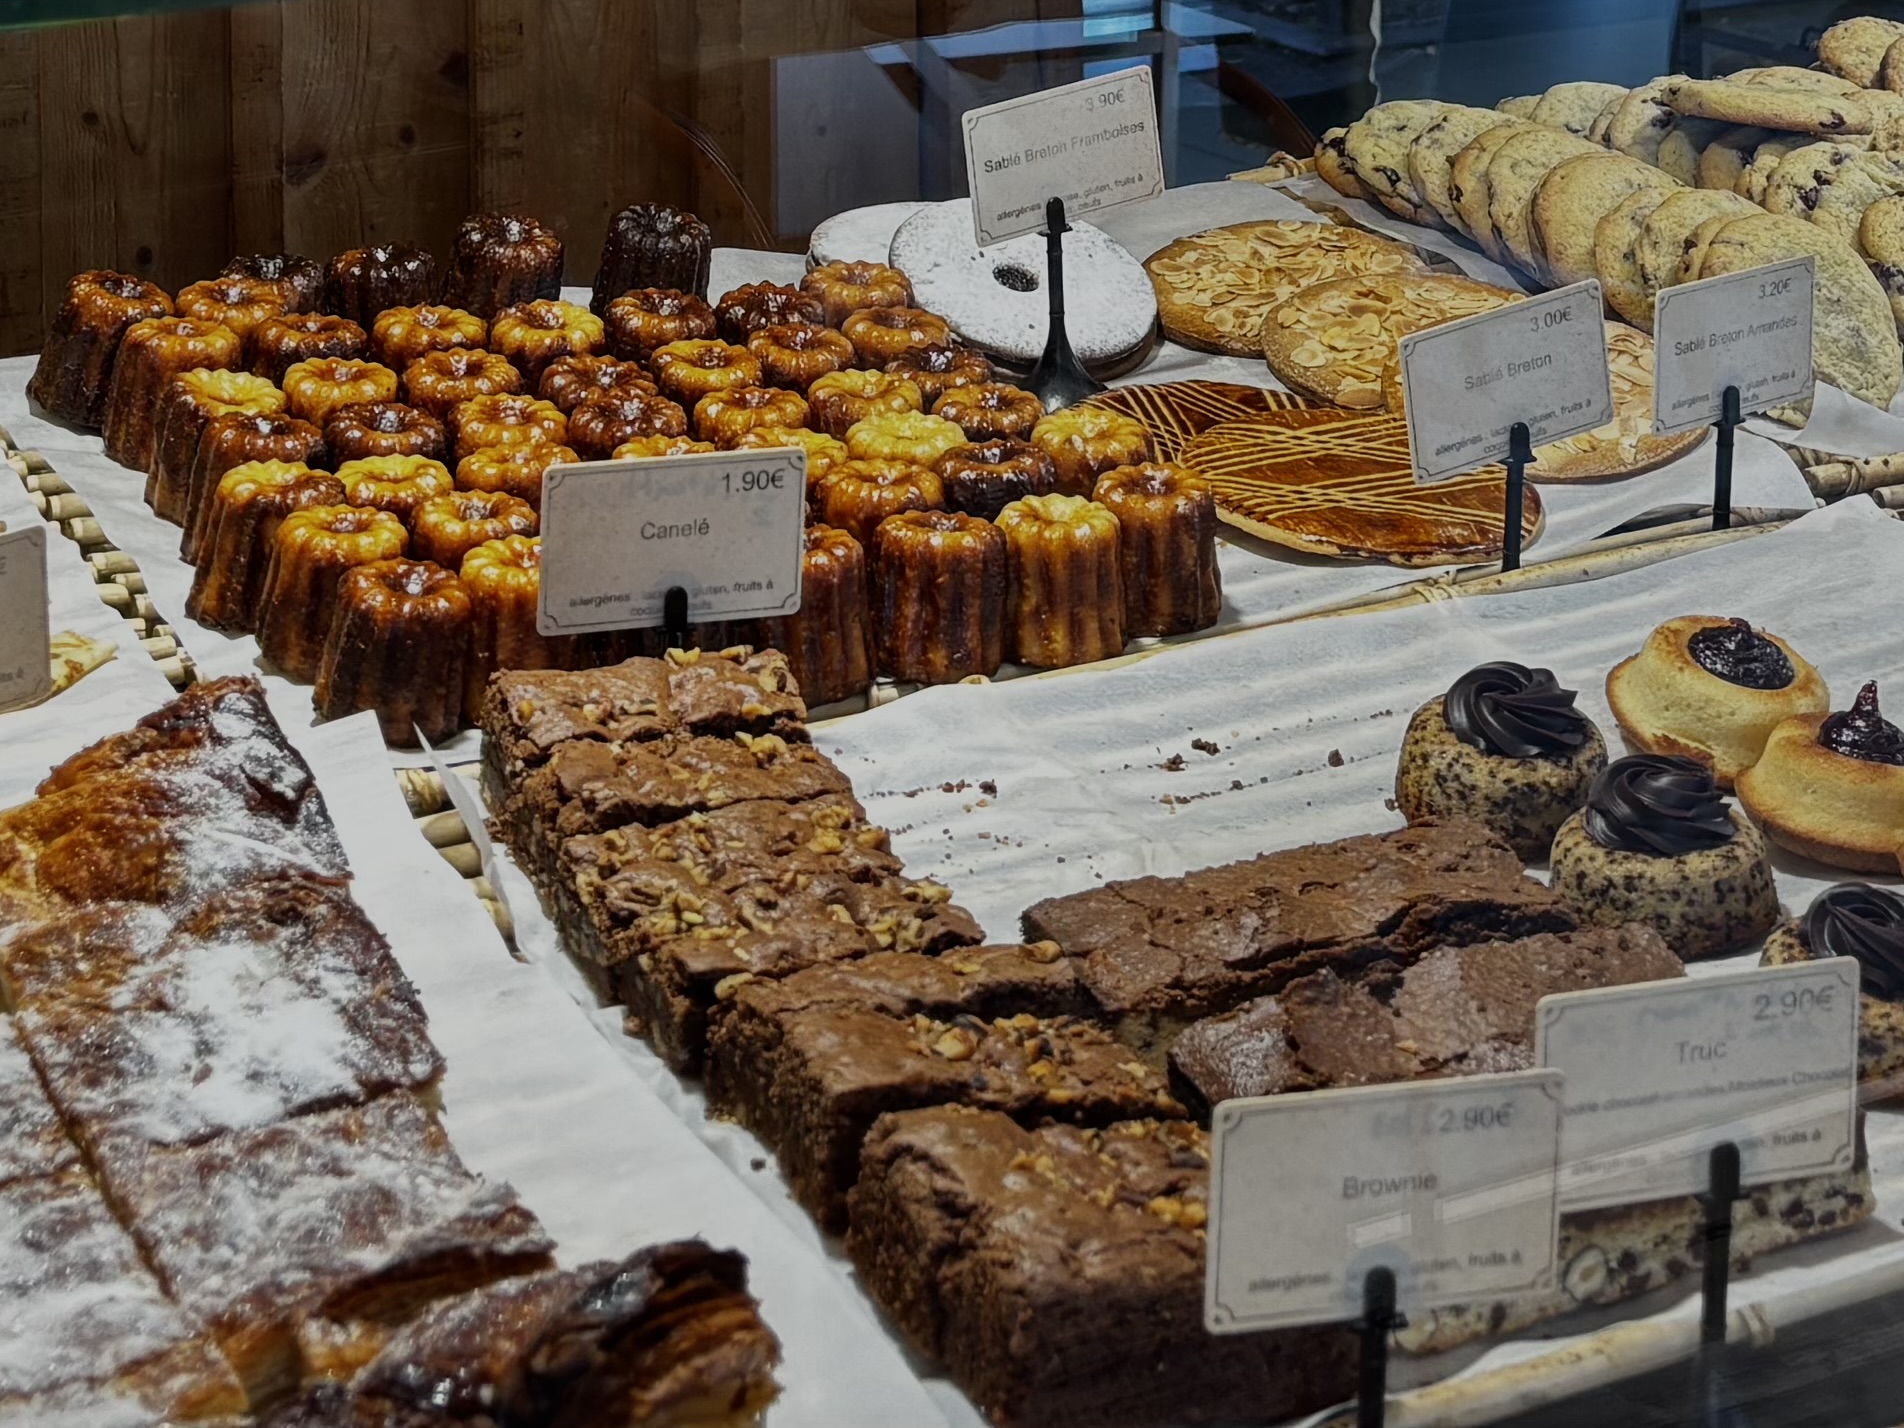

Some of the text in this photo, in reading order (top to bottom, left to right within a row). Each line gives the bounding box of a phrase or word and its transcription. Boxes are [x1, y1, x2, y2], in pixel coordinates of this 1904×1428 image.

[983, 120, 1146, 174] Sablé Breton Framboises
[1757, 276, 1793, 301] 3.20€
[1529, 304, 1573, 334] 3.00€
[1673, 313, 1798, 358] Sablé Breton Amandes
[1463, 352, 1552, 392] Sablé Breton
[720, 467, 787, 495] 1.90€
[639, 517, 710, 541] Canelé
[1752, 985, 1837, 1023] 2.90€
[1674, 1040, 1729, 1066] Truc
[1438, 1101, 1515, 1134] 2.90€
[1341, 1171, 1439, 1200] Brownie
